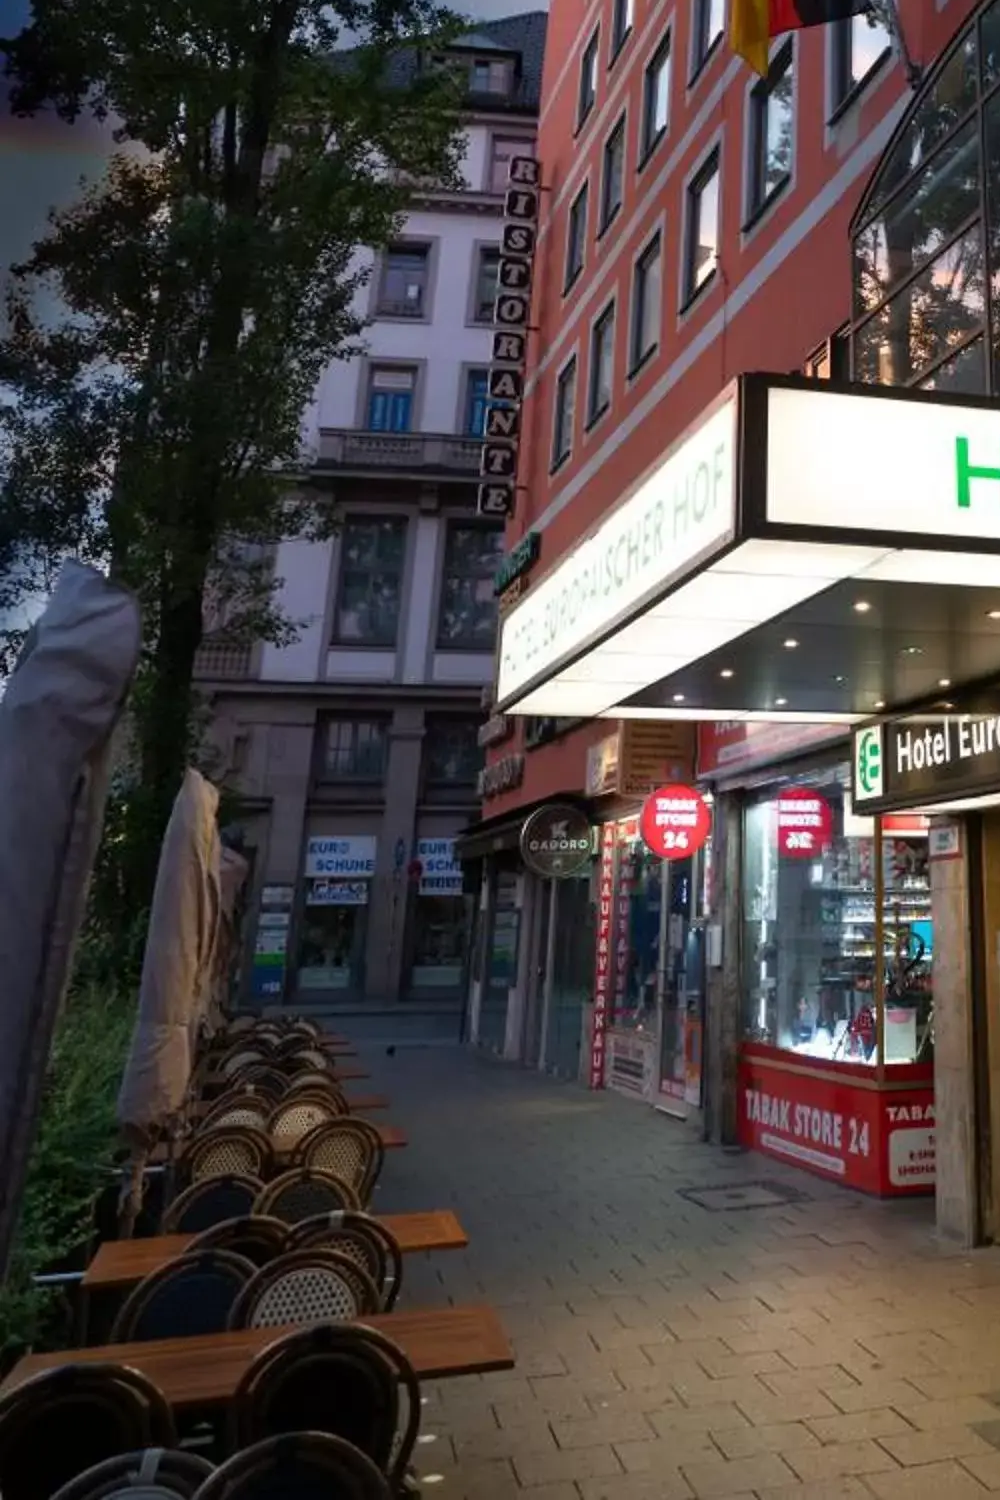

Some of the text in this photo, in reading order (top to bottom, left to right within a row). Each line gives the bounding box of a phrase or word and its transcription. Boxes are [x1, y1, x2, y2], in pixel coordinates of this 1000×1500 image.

[483, 159, 537, 513] RISTORANTE
[672, 440, 726, 541] HOF
[896, 715, 951, 773] Hotel
[315, 859, 375, 872] SCHUHE
[662, 831, 689, 849] 24
[591, 955, 608, 1090] VERKAUF
[745, 1088, 791, 1133] TABAK
[794, 1102, 843, 1150] STORE
[847, 1117, 870, 1158] 24
